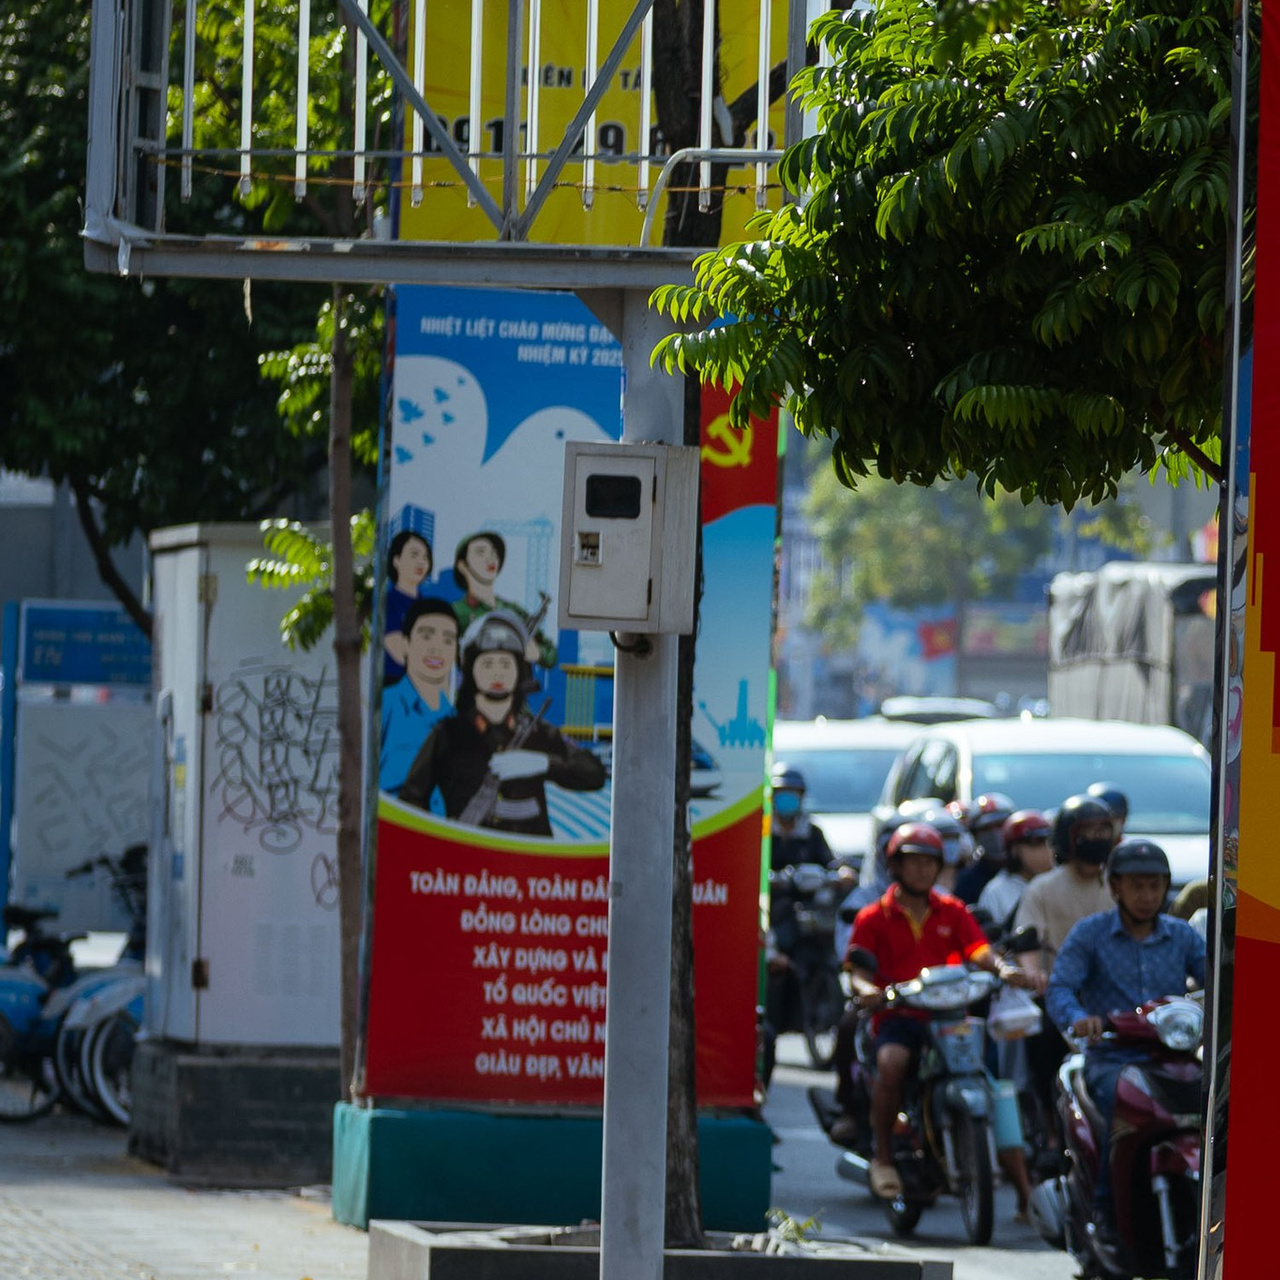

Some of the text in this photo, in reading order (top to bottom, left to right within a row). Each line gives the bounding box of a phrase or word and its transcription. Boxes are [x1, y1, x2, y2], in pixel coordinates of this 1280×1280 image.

[410, 868, 459, 895] TOÀN
[527, 873, 577, 900] TOÀN
[581, 875, 609, 901] DÂ
[691, 878, 728, 905] UÂN
[473, 941, 510, 969] XÂY
[572, 945, 598, 972] VÀ
[512, 1013, 547, 1047] HỘI
